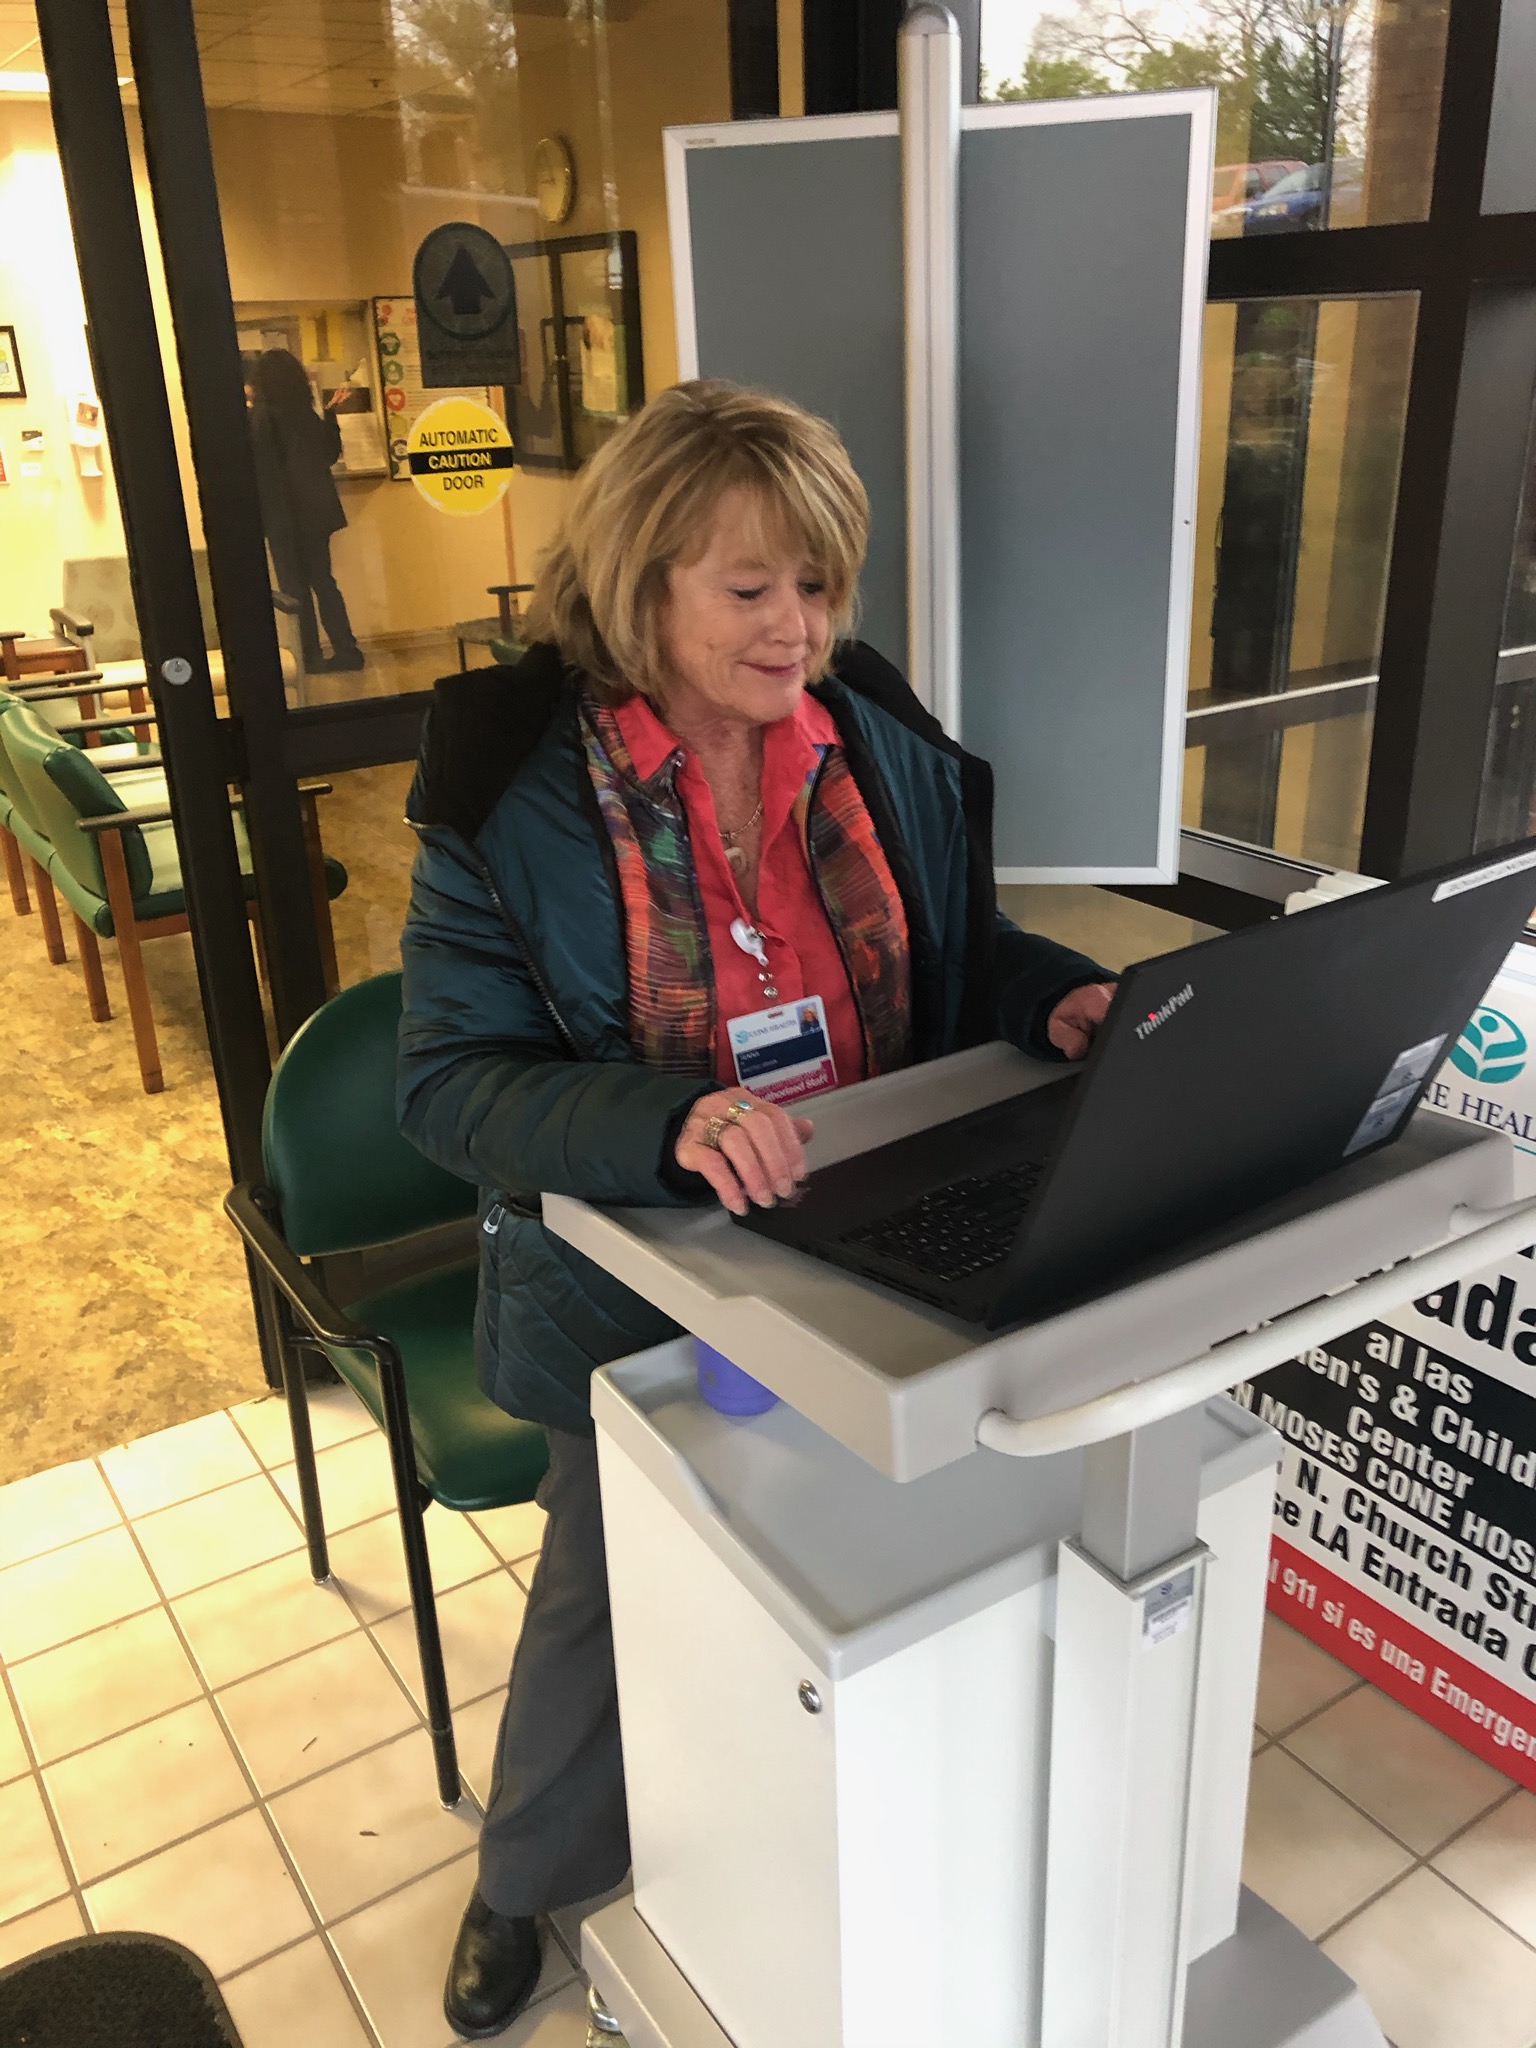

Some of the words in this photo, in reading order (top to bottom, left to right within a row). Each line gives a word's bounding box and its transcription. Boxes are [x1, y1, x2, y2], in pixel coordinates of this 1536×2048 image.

[419, 428, 499, 447] AUTOMATIC
[428, 452, 492, 470] CAUTION
[443, 474, 485, 491] DOOR
[1133, 982, 1195, 1041] ThinkPad
[1365, 1331, 1405, 1371] al
[1413, 1346, 1474, 1404] las
[1347, 1405, 1475, 1499] Center
[1389, 1384, 1420, 1427] &
[1431, 1405, 1536, 1490] Child
[1259, 1392, 1361, 1473] MOSES
[1366, 1456, 1454, 1529] CONE
[1460, 1509, 1536, 1581] HOS
[1296, 1457, 1330, 1506] N.
[1343, 1487, 1472, 1592] Church
[1281, 1567, 1317, 1610] 911
[1321, 1600, 1346, 1629] si
[1347, 1618, 1378, 1651] es
[1380, 1639, 1427, 1685] una
[1309, 1509, 1351, 1563] LA
[1360, 1541, 1510, 1662] Entrada
